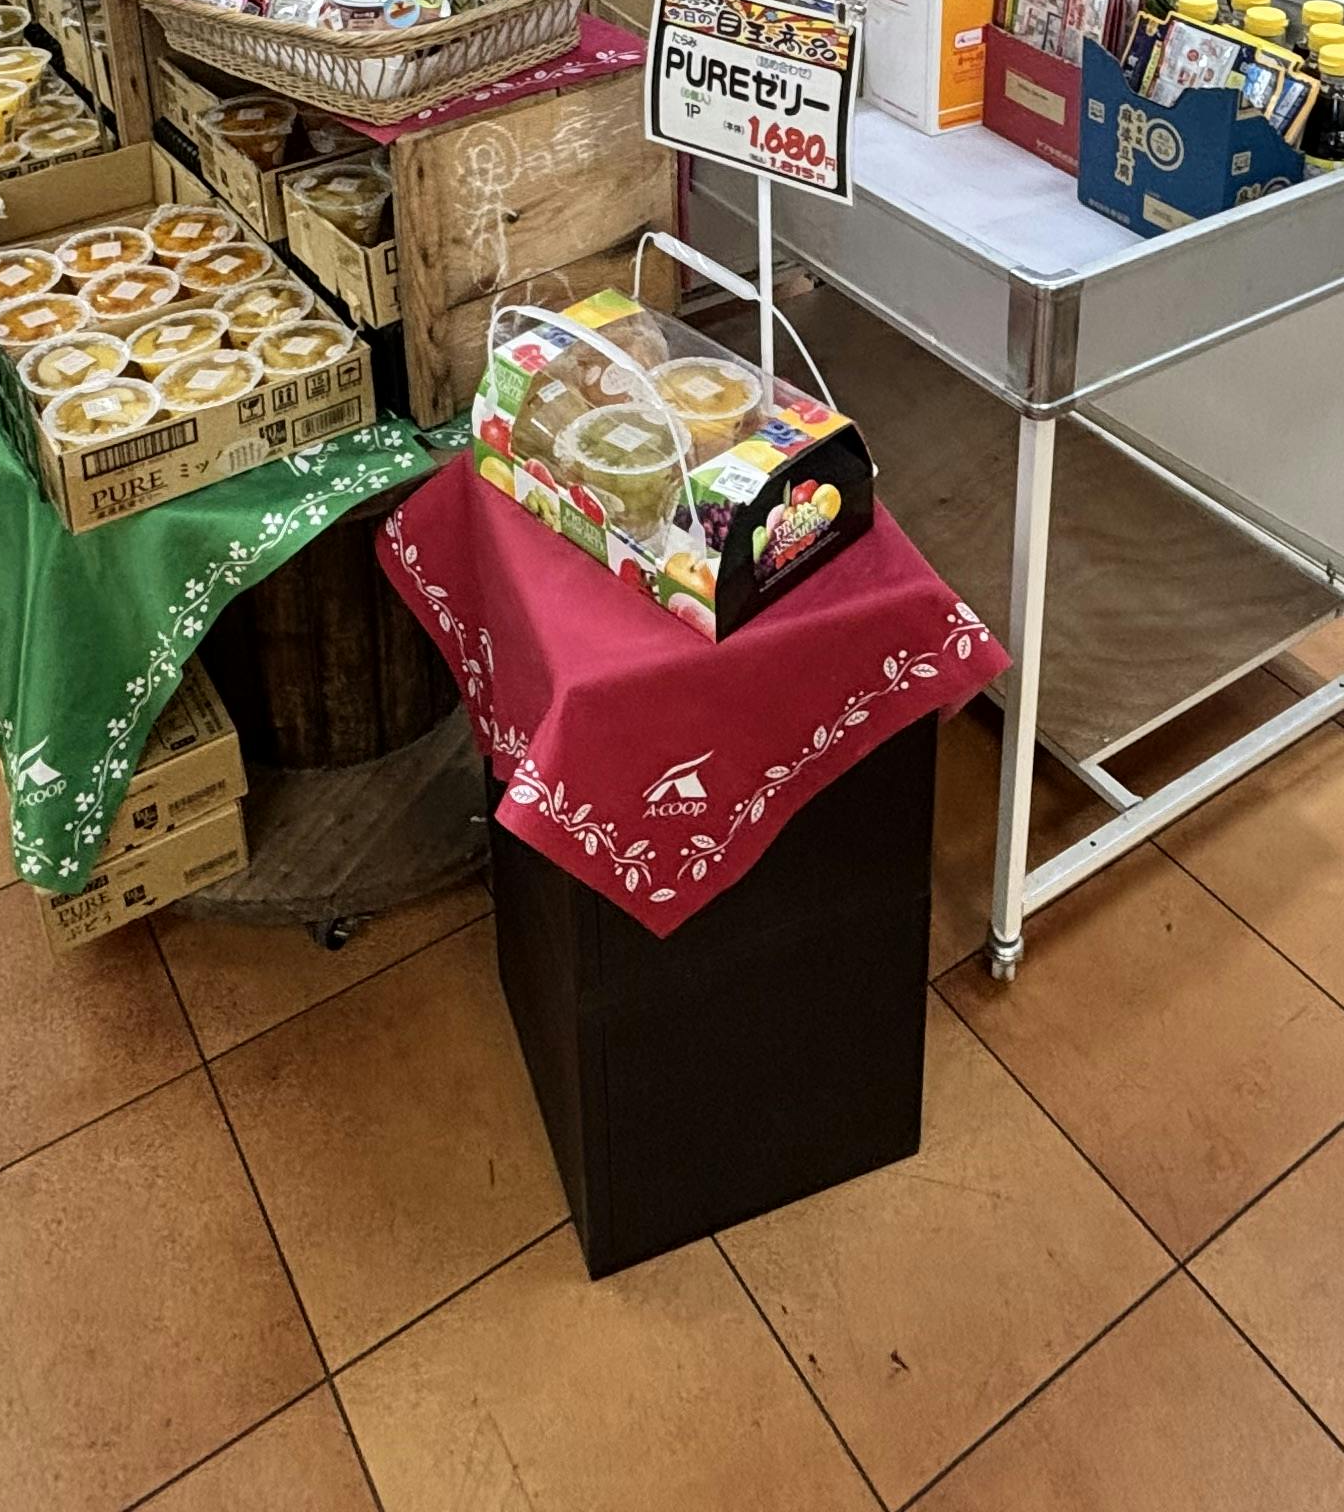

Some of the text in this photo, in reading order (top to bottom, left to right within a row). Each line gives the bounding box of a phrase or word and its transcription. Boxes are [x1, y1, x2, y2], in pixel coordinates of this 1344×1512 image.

[671, 31, 698, 49] たらみ
[664, 44, 831, 117] PUREゼリー
[684, 101, 702, 120] 1P
[311, 375, 325, 387] 15
[90, 470, 168, 510] PURE
[773, 501, 818, 542] FRUITS
[56, 892, 113, 926] PURE
